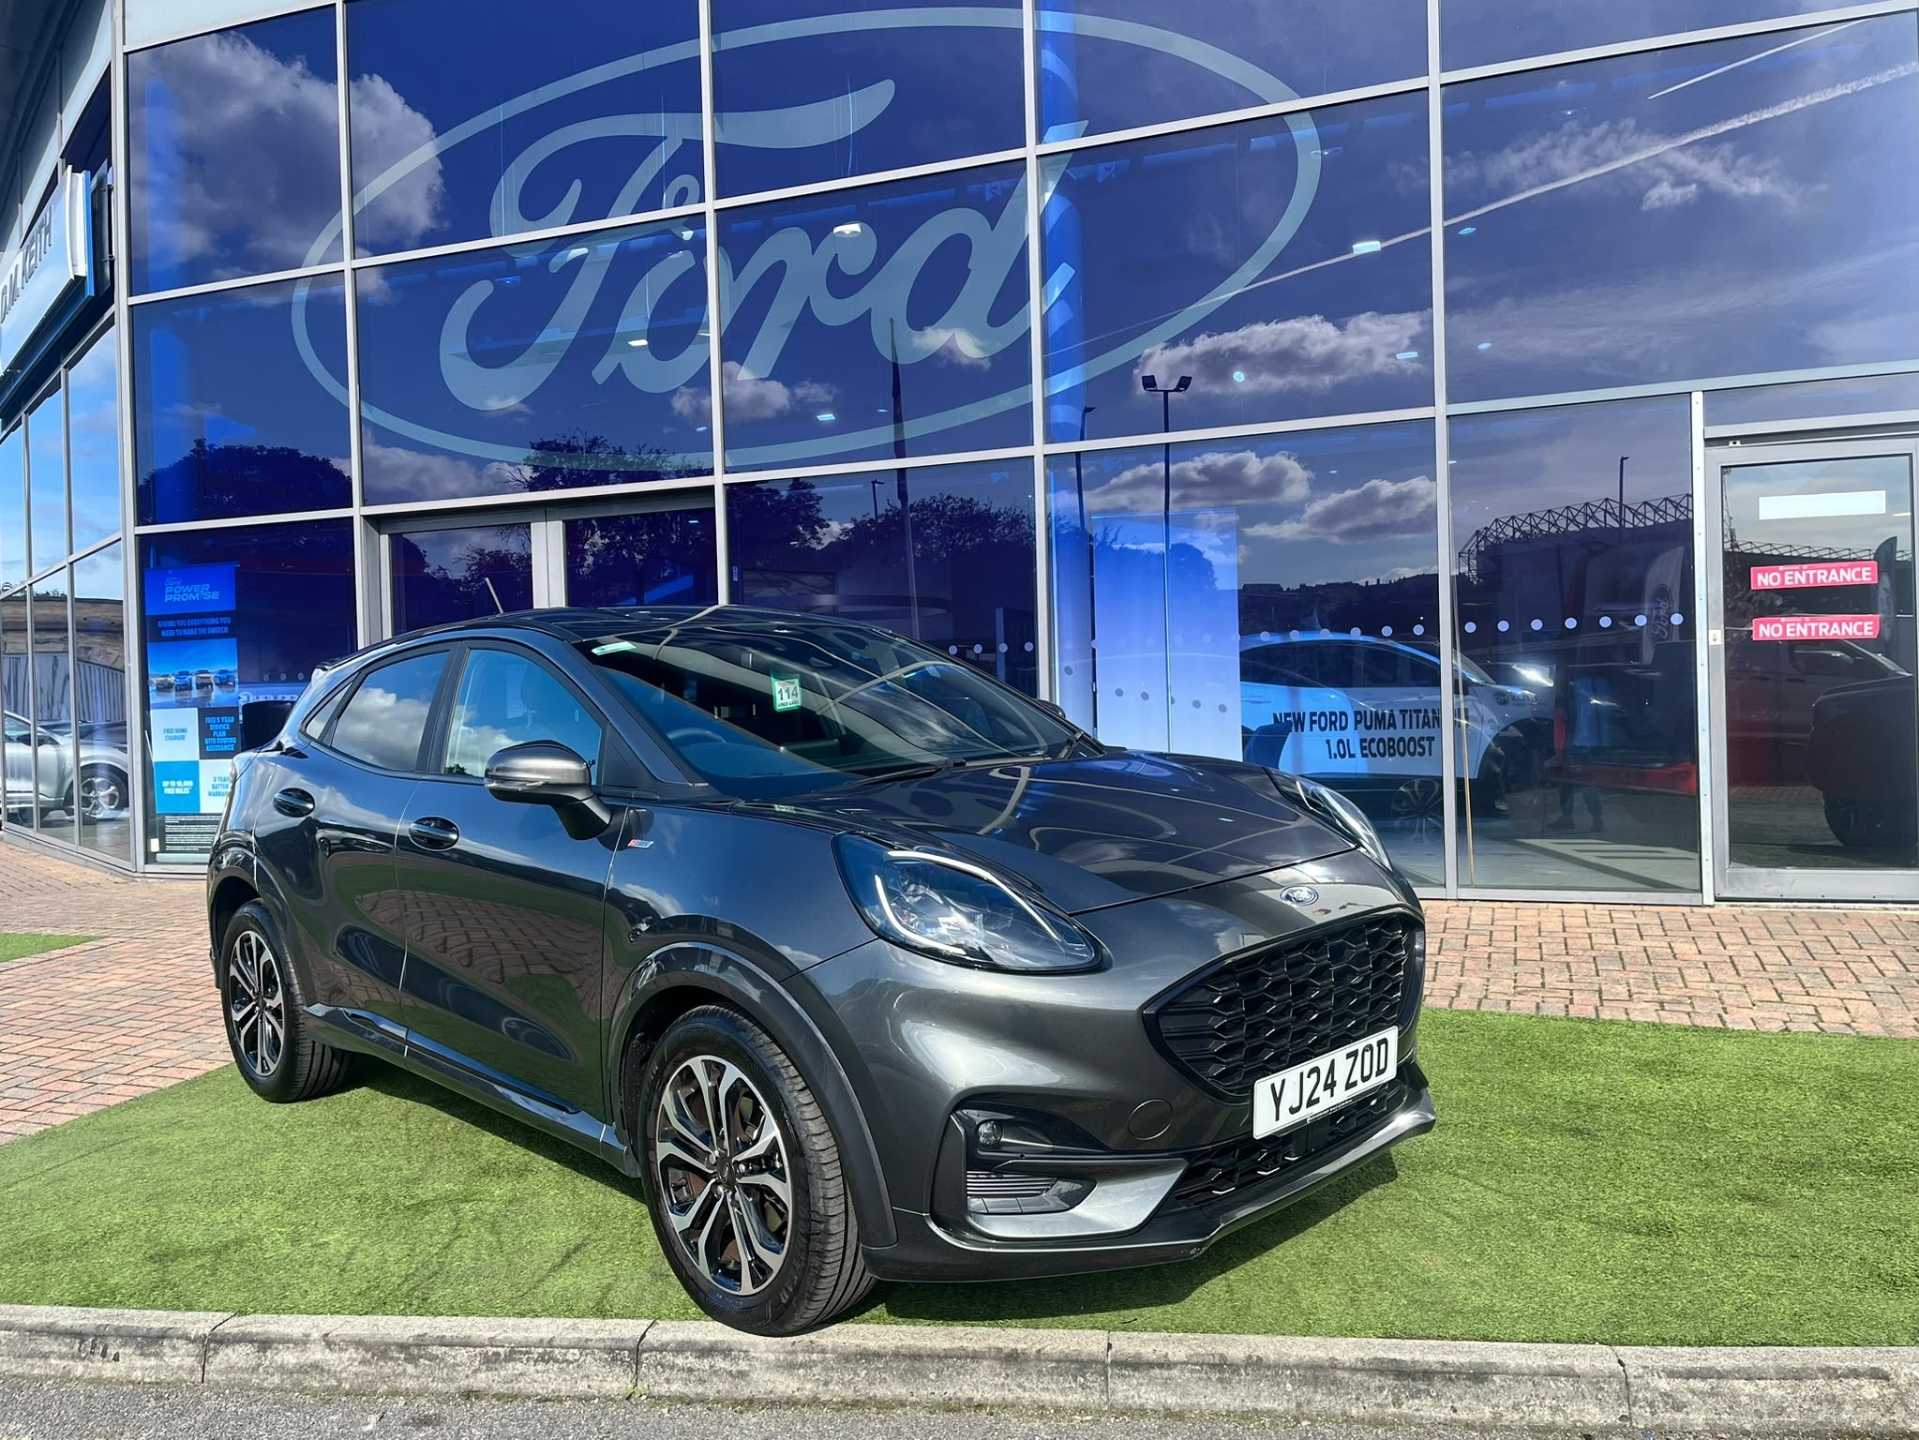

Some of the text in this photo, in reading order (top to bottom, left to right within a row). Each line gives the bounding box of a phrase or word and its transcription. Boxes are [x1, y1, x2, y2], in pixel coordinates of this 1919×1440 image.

[440, 79, 1086, 410] Ford
[1757, 567, 1872, 586] NO ENTRANCE
[164, 583, 210, 593] POWER
[1759, 621, 1873, 637] NO ENTRANCE
[778, 686, 799, 701] 114
[1273, 711, 1306, 733] NEW
[1309, 710, 1348, 732] FORD
[1353, 708, 1397, 731] PUMA
[1325, 735, 1435, 760] 1.0L ECOBOOST
[1270, 1036, 1389, 1122] YJ24 ZOD
